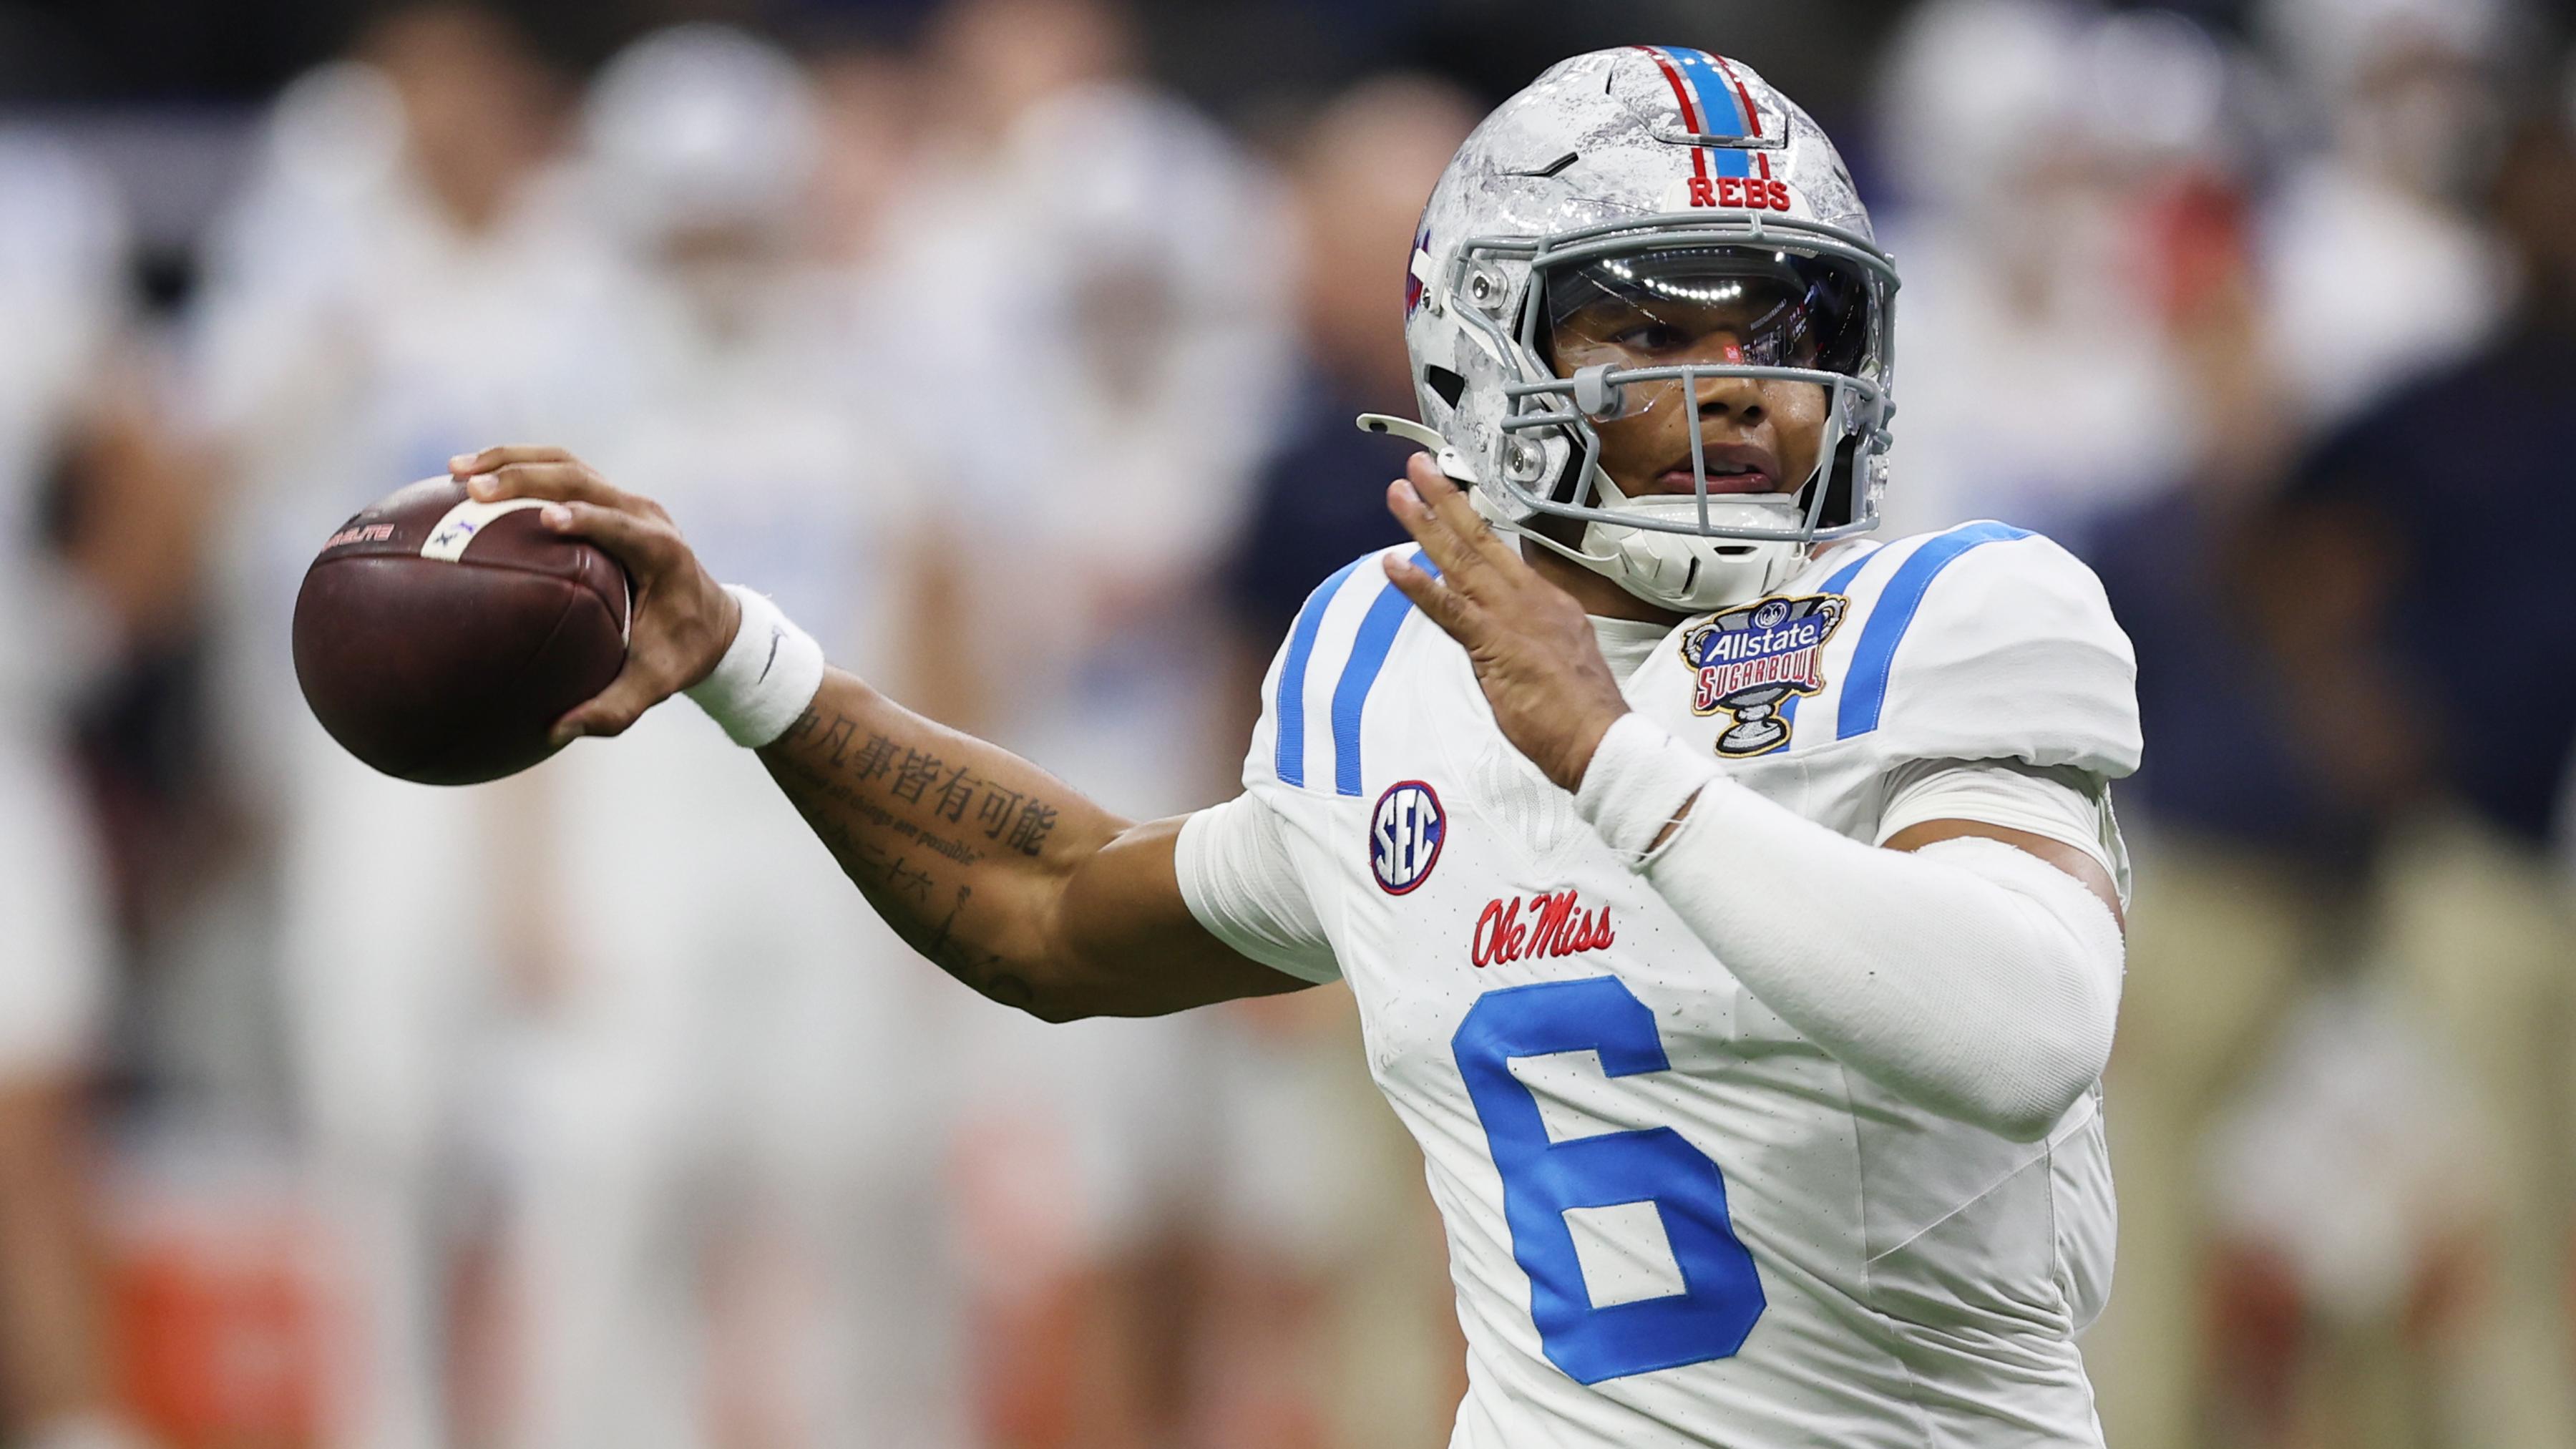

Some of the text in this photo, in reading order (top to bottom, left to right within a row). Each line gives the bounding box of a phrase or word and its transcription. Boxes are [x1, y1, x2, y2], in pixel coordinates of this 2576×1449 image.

[1688, 177, 1790, 211] REBS
[1705, 623, 1815, 663] Allstate
[1375, 789, 1438, 886] SEC
[1472, 890, 1614, 967] Ole Miss
[1451, 975, 1766, 1385] 6
